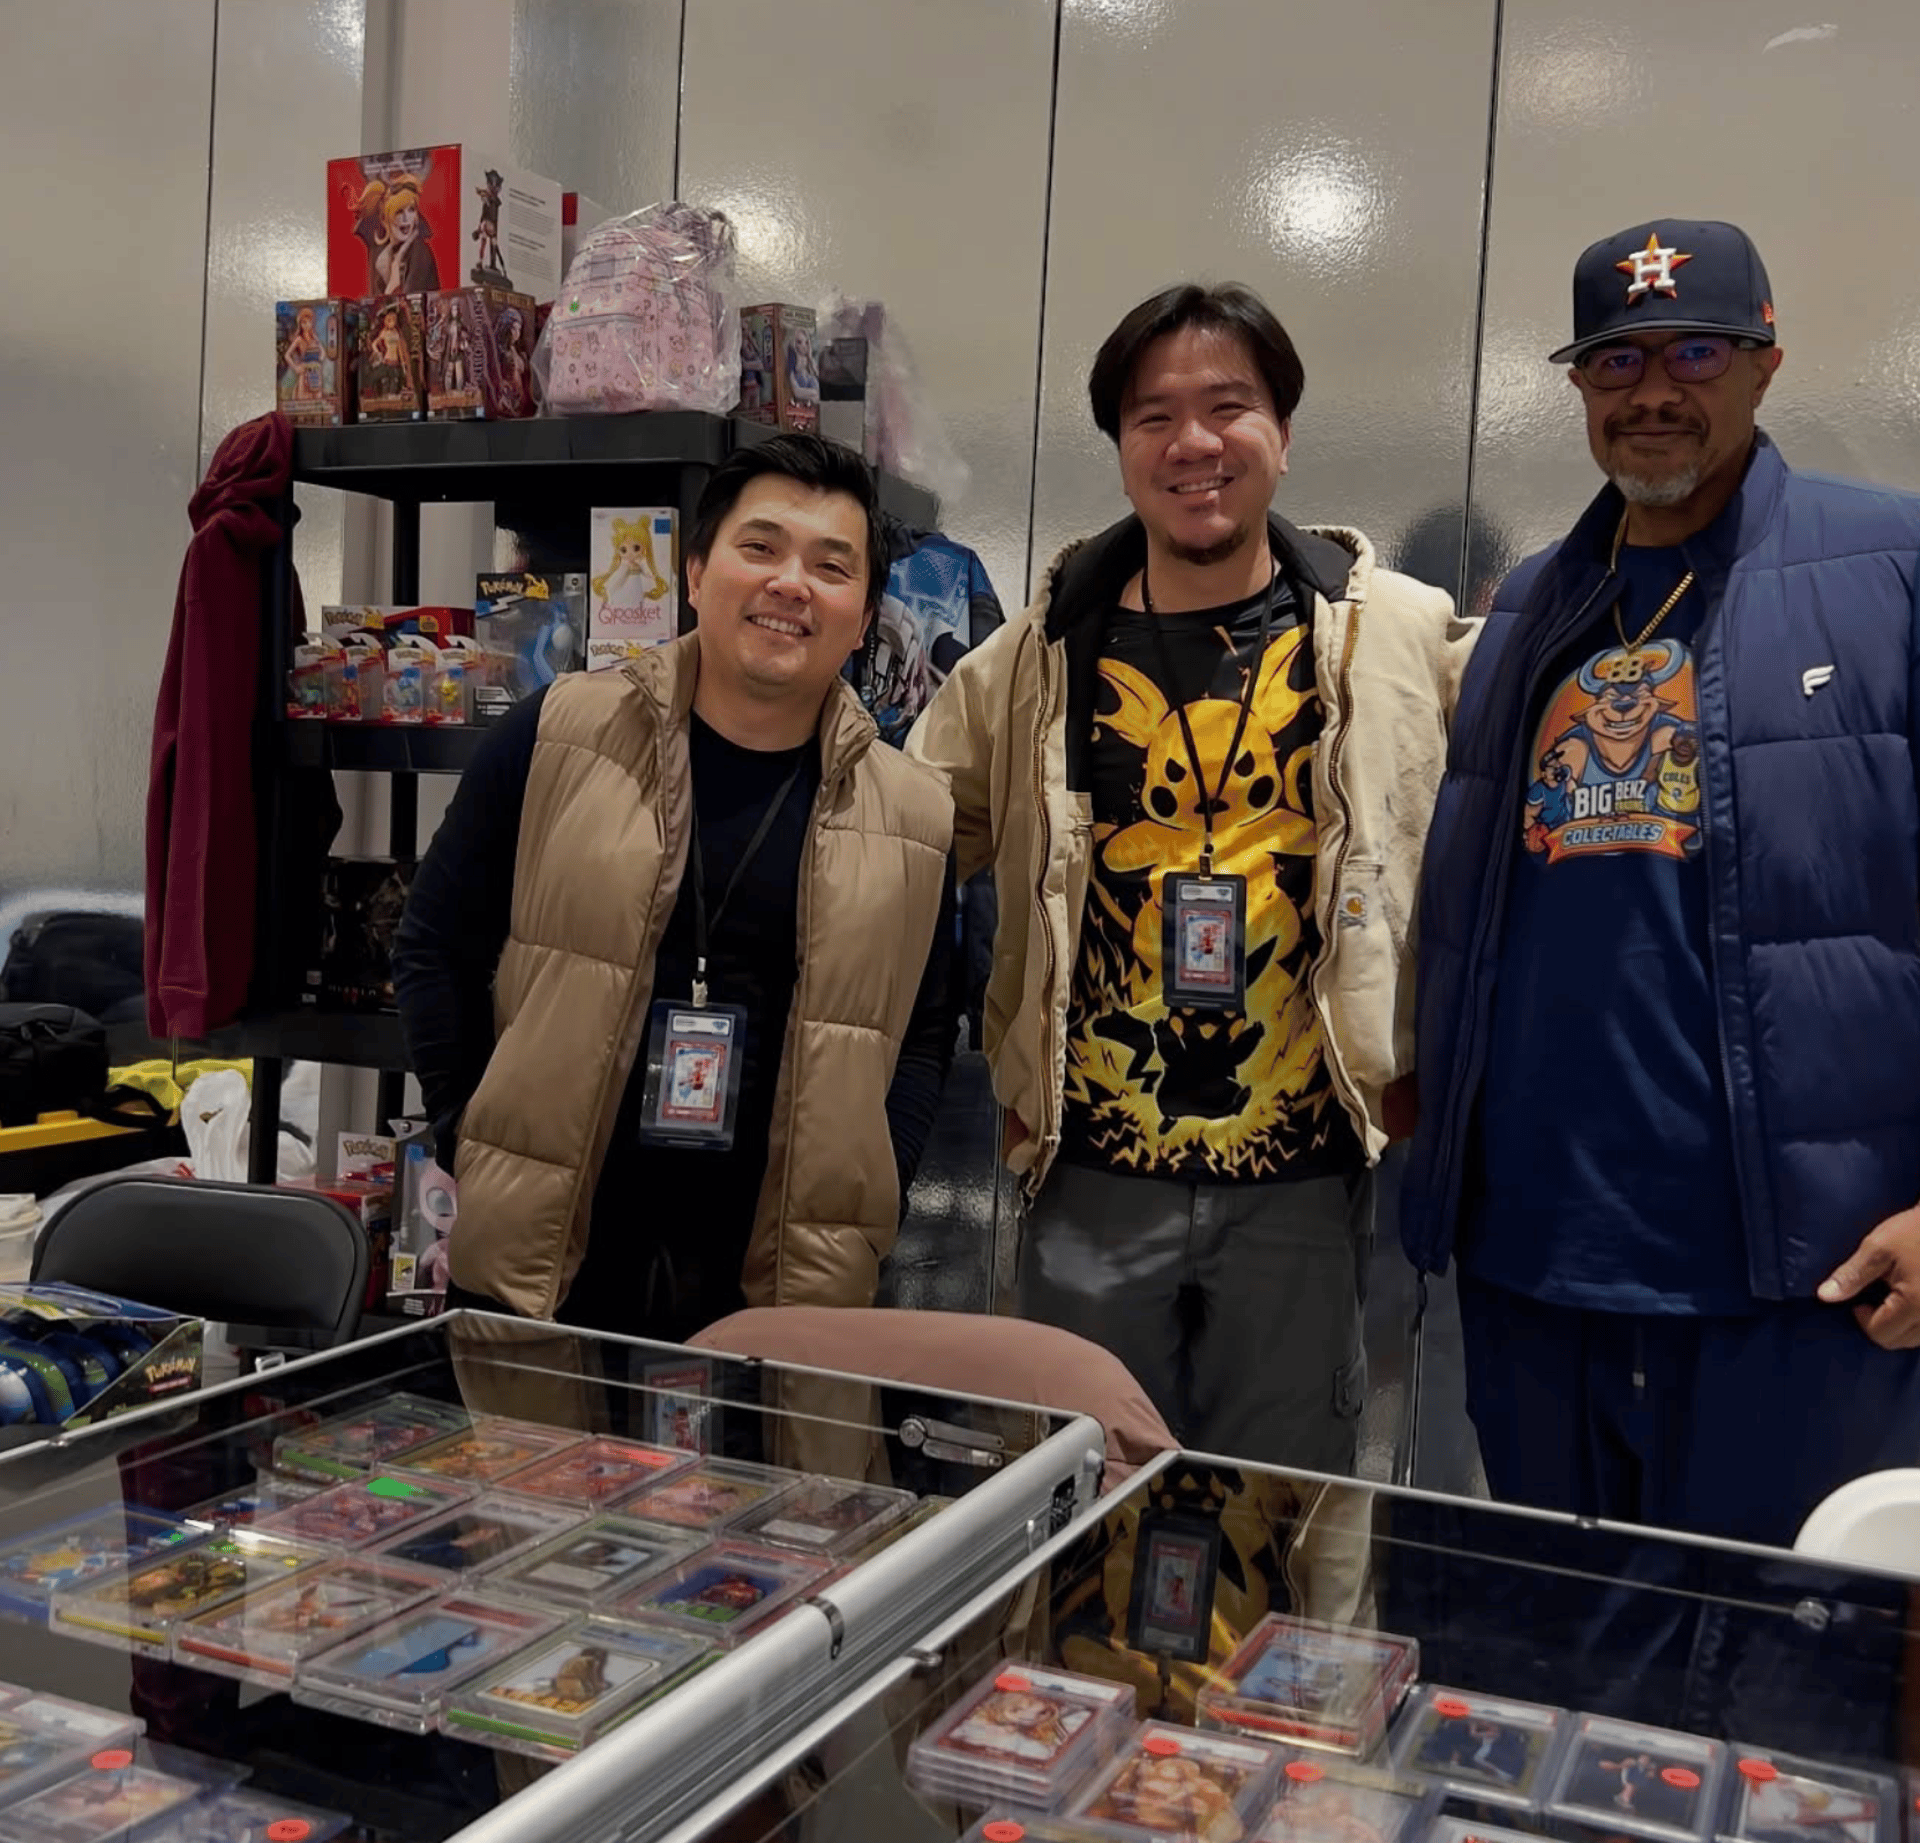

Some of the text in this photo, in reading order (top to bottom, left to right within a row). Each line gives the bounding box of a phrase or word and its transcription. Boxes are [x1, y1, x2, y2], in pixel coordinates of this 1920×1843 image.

[1627, 247, 1677, 293] H
[1574, 783, 1612, 819] BIG
[1614, 780, 1647, 800] BENZ
[1562, 823, 1664, 847] COLECTABLES
